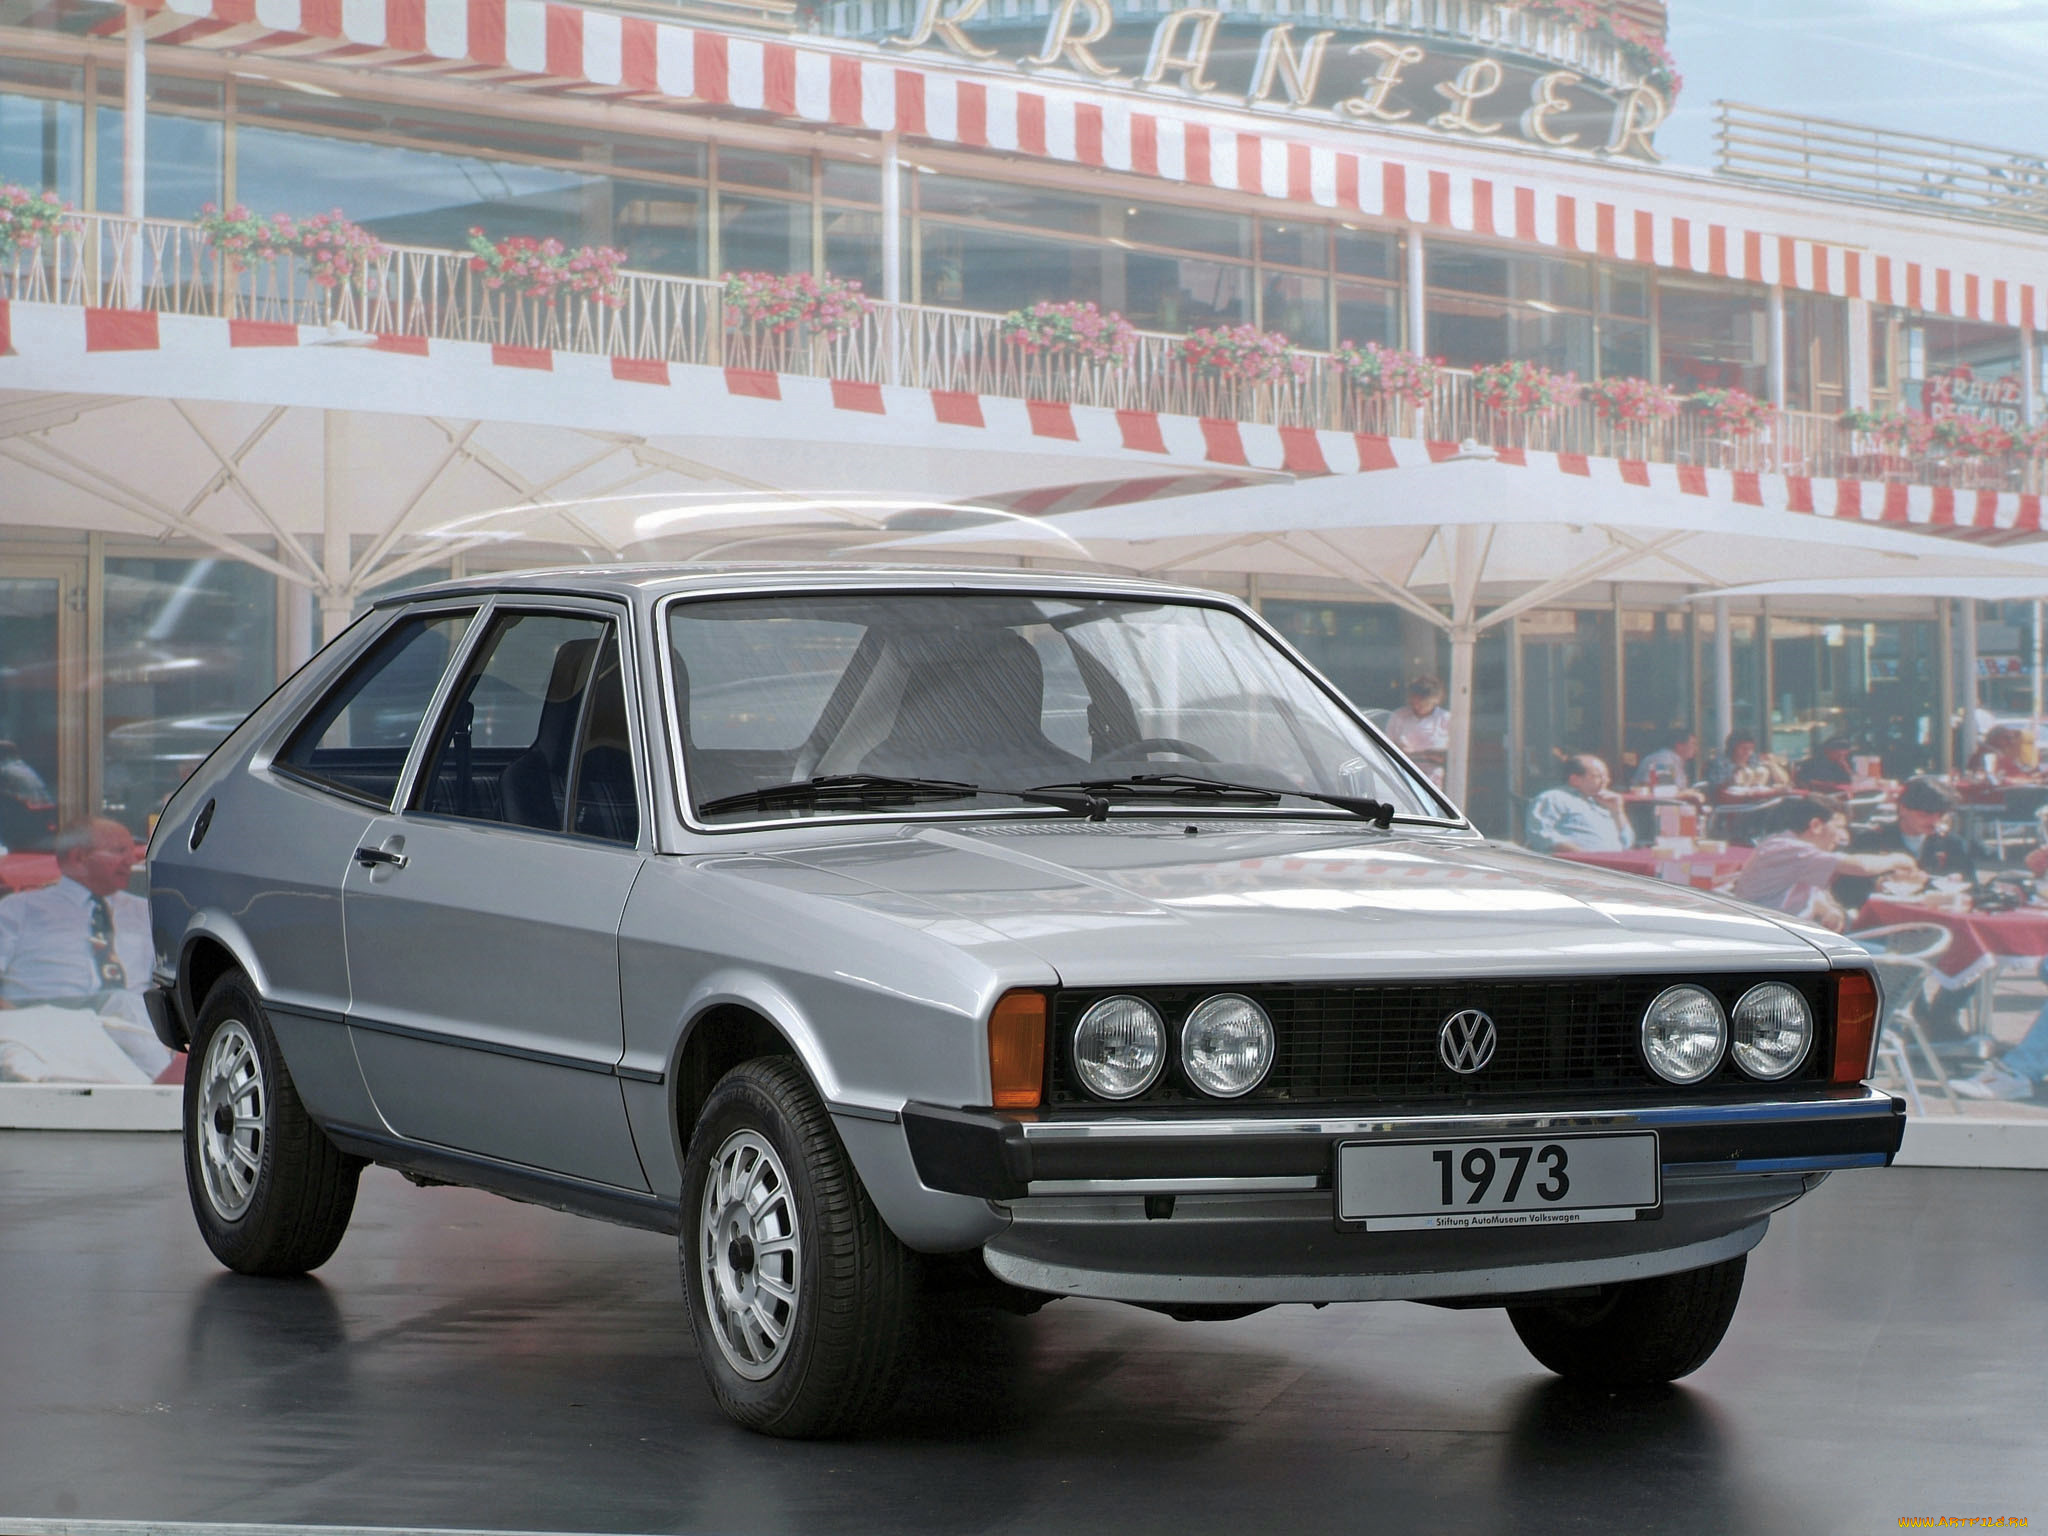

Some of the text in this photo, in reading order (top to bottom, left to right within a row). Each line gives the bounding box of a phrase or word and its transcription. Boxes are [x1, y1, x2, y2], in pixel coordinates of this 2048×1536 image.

[886, 0, 1668, 160] KRANZLER
[1441, 1009, 1497, 1074] VW
[1432, 1144, 1571, 1206] 1973
[1436, 1213, 1580, 1227] Stiftung AutoMuseum Volkswagen
